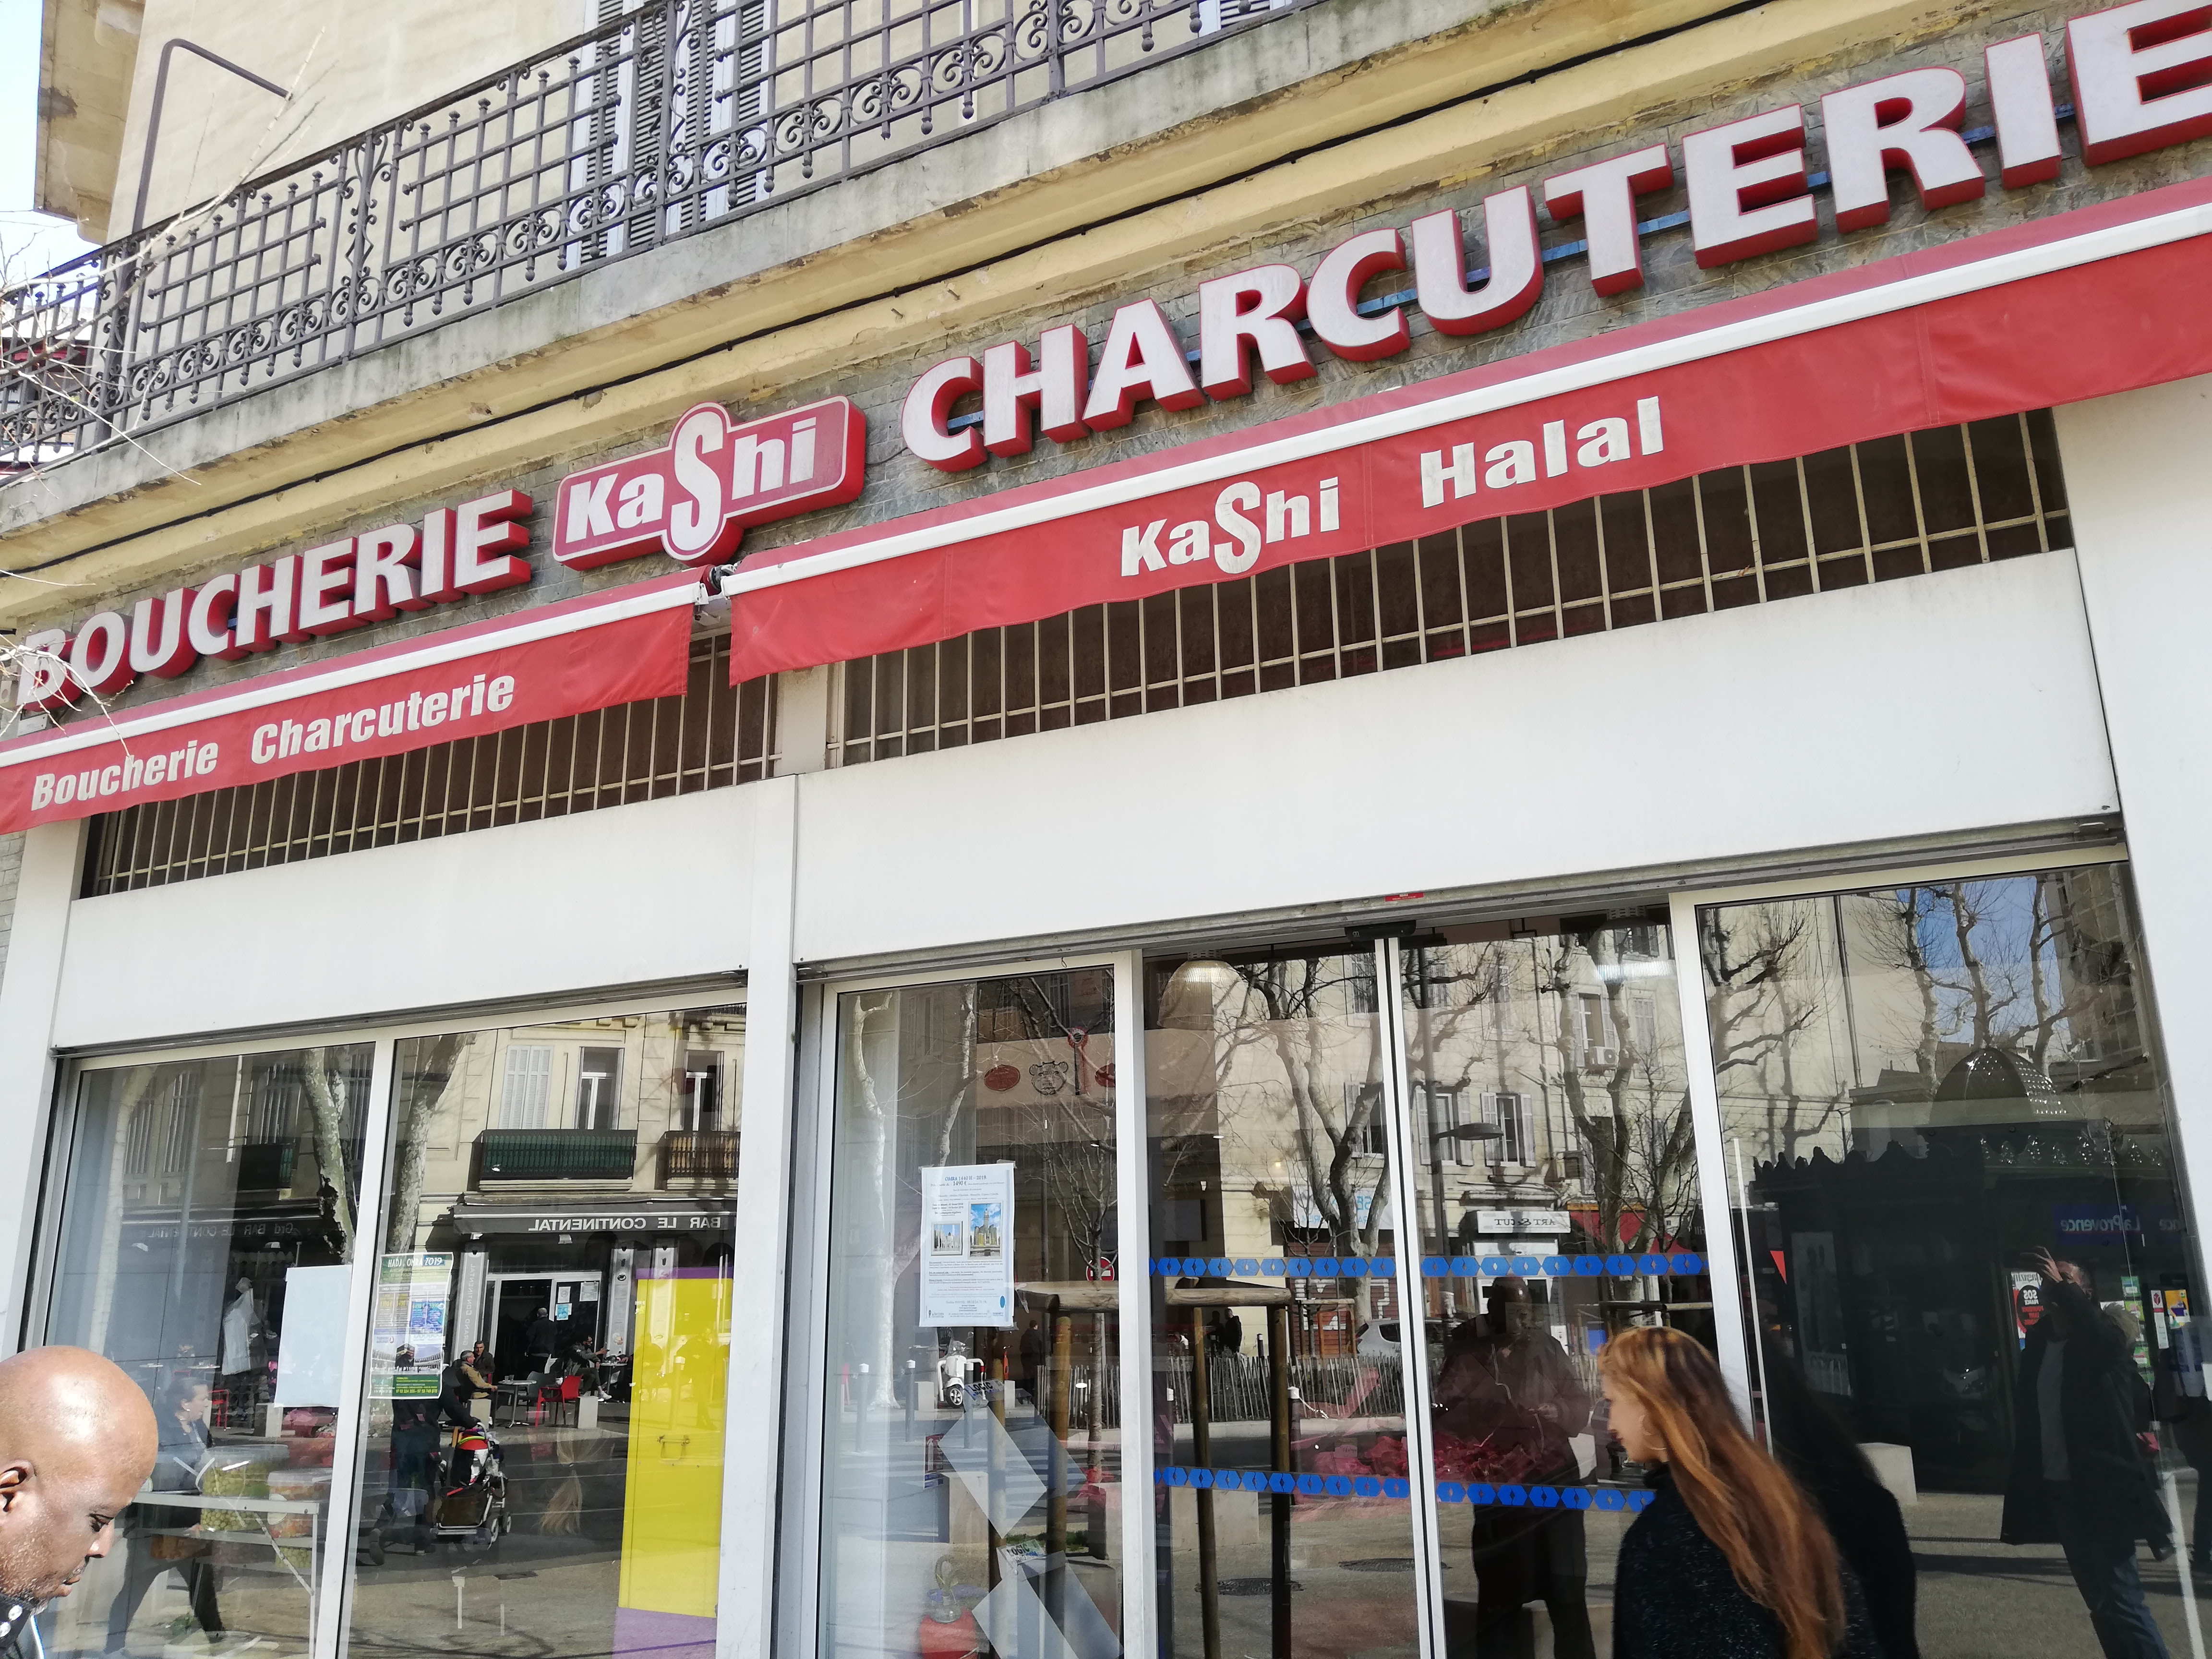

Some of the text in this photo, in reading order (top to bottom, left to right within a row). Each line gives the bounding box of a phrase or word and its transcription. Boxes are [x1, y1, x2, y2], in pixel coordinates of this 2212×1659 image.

[17, 489, 533, 711] BOUCHERIE
[901, 0, 2212, 472] CHARCUTERIE
[1419, 396, 1664, 508] Halal
[31, 673, 514, 811] Boucherie Charcuterie
[388, 1259, 402, 1268] HADJ
[424, 1257, 443, 1265] 2019
[1007, 1543, 1030, 1556] LOGIC
